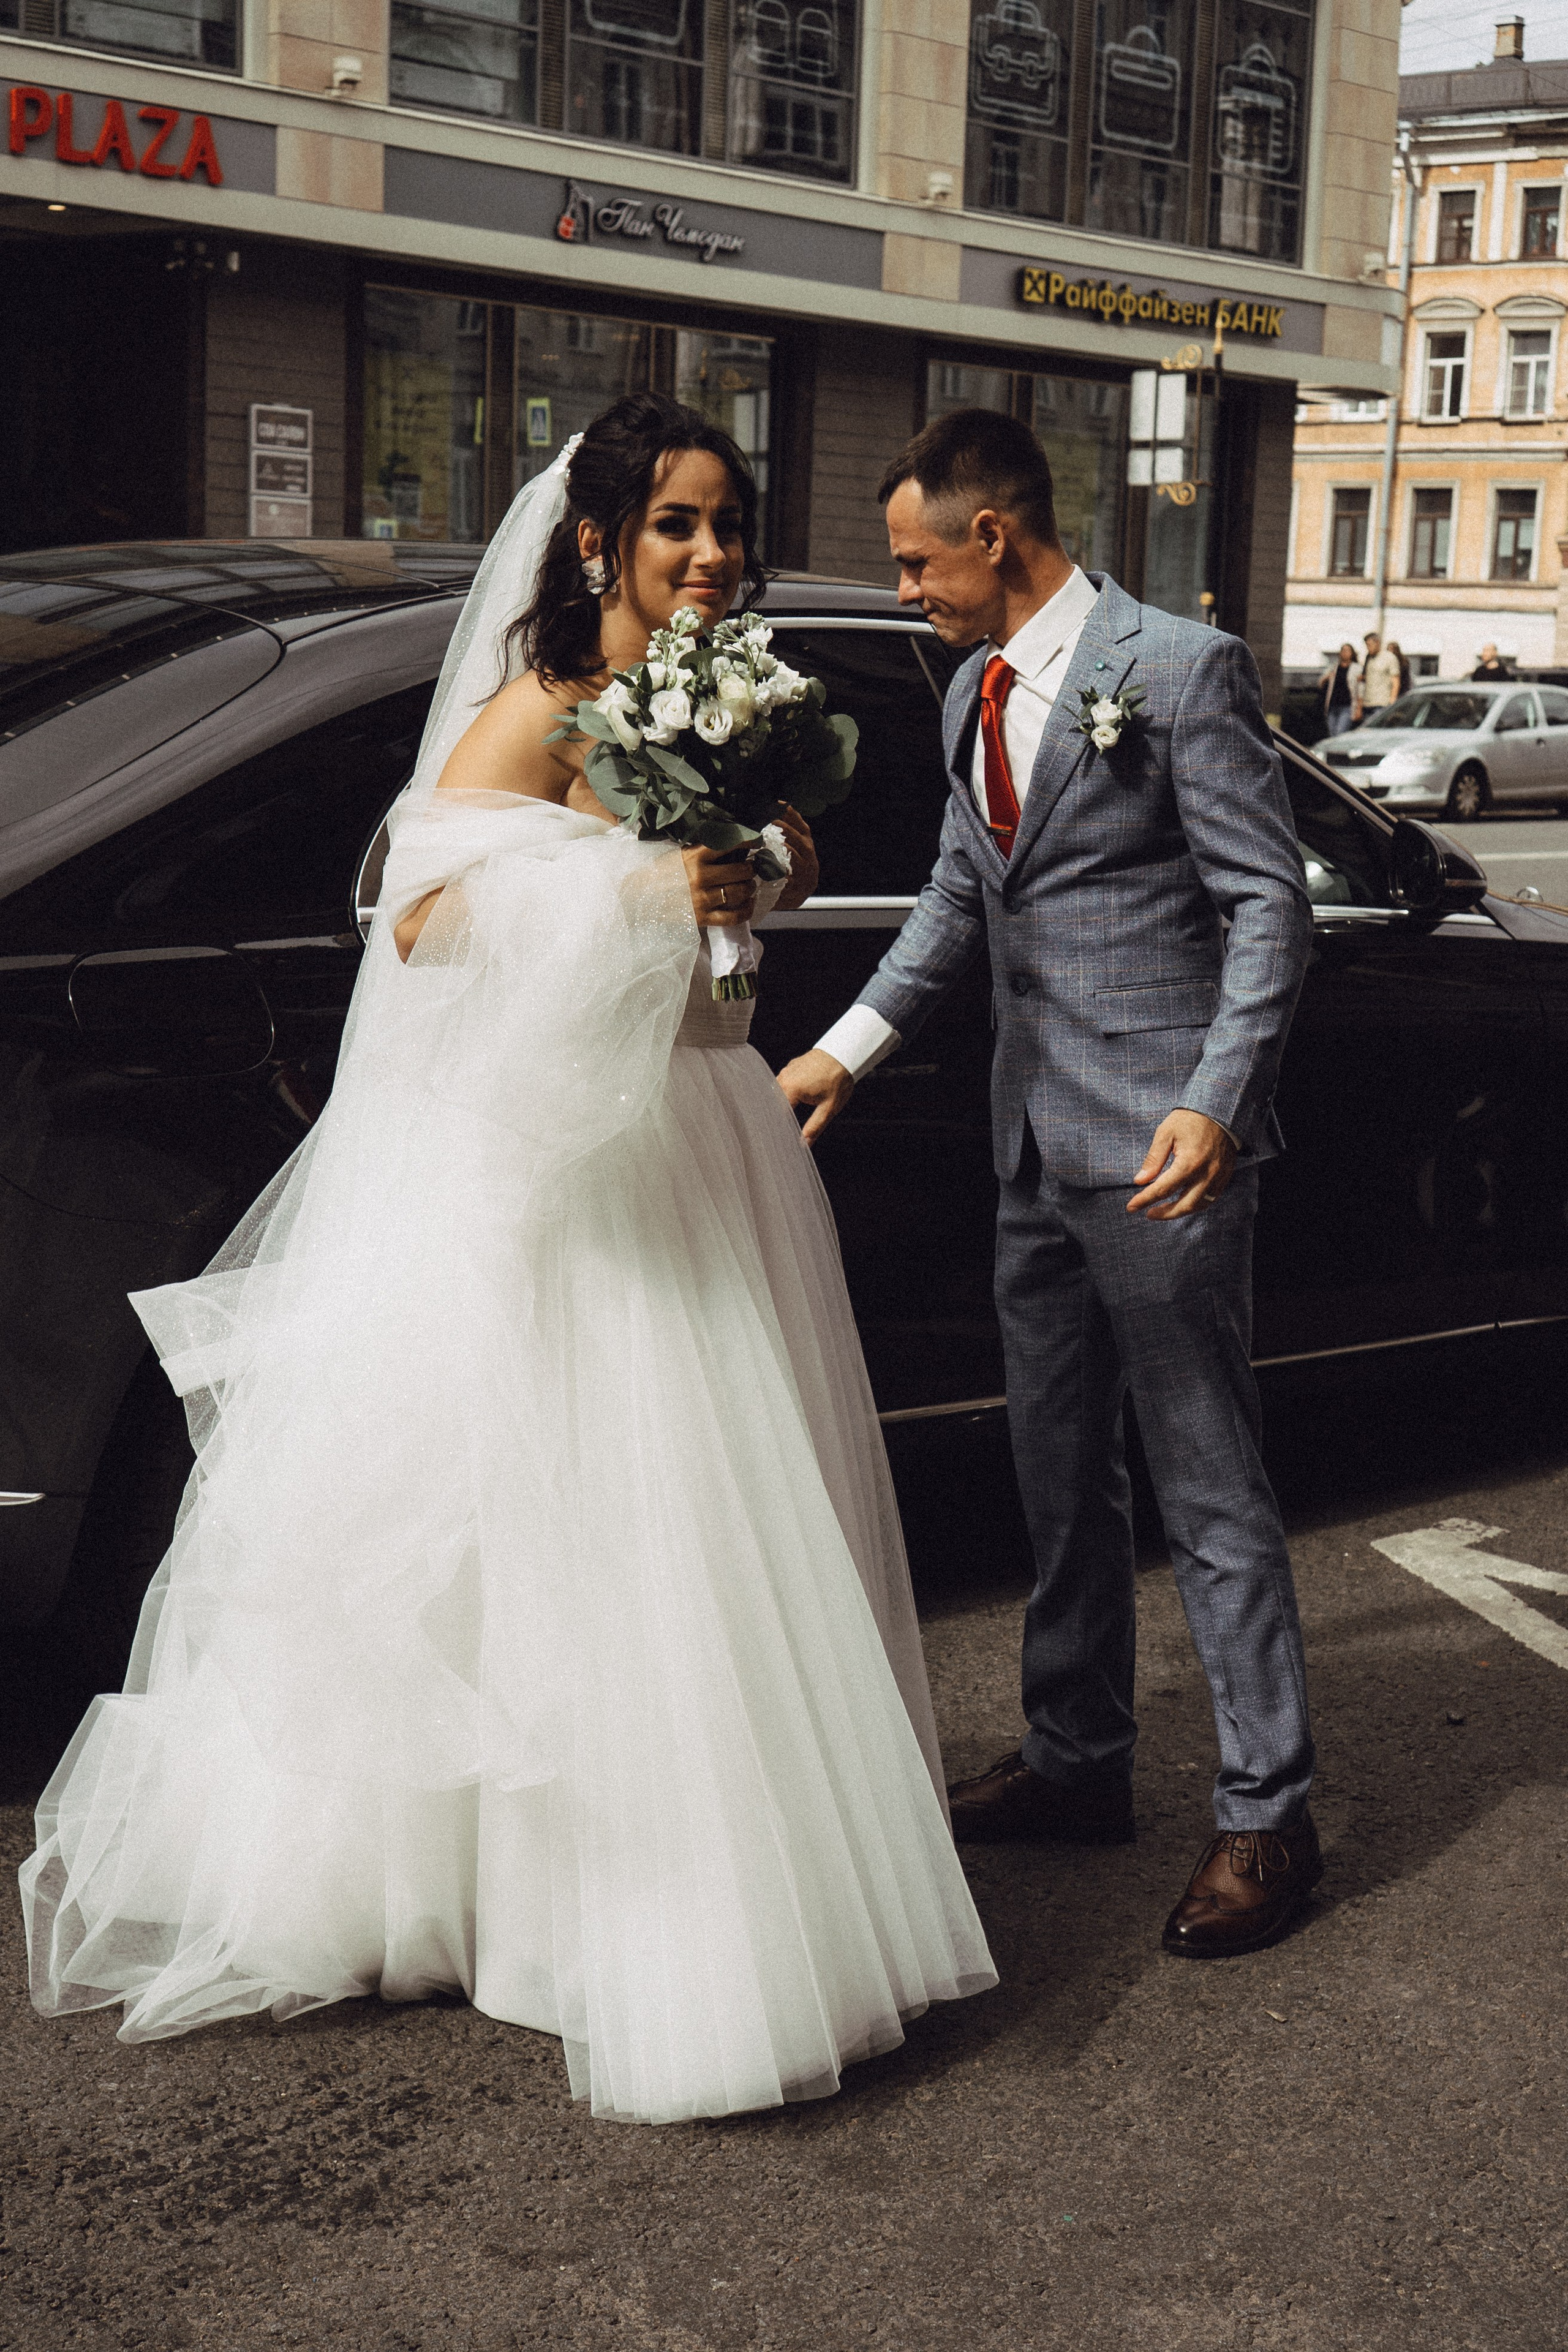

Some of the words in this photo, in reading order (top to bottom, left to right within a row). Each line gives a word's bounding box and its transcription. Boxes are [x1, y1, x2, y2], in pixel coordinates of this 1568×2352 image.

[9, 87, 224, 185] PLAZA
[597, 198, 655, 237] Пан
[655, 203, 745, 263] Чемодан
[1048, 271, 1210, 326] Райффайзен
[1215, 298, 1284, 337] БАНК
